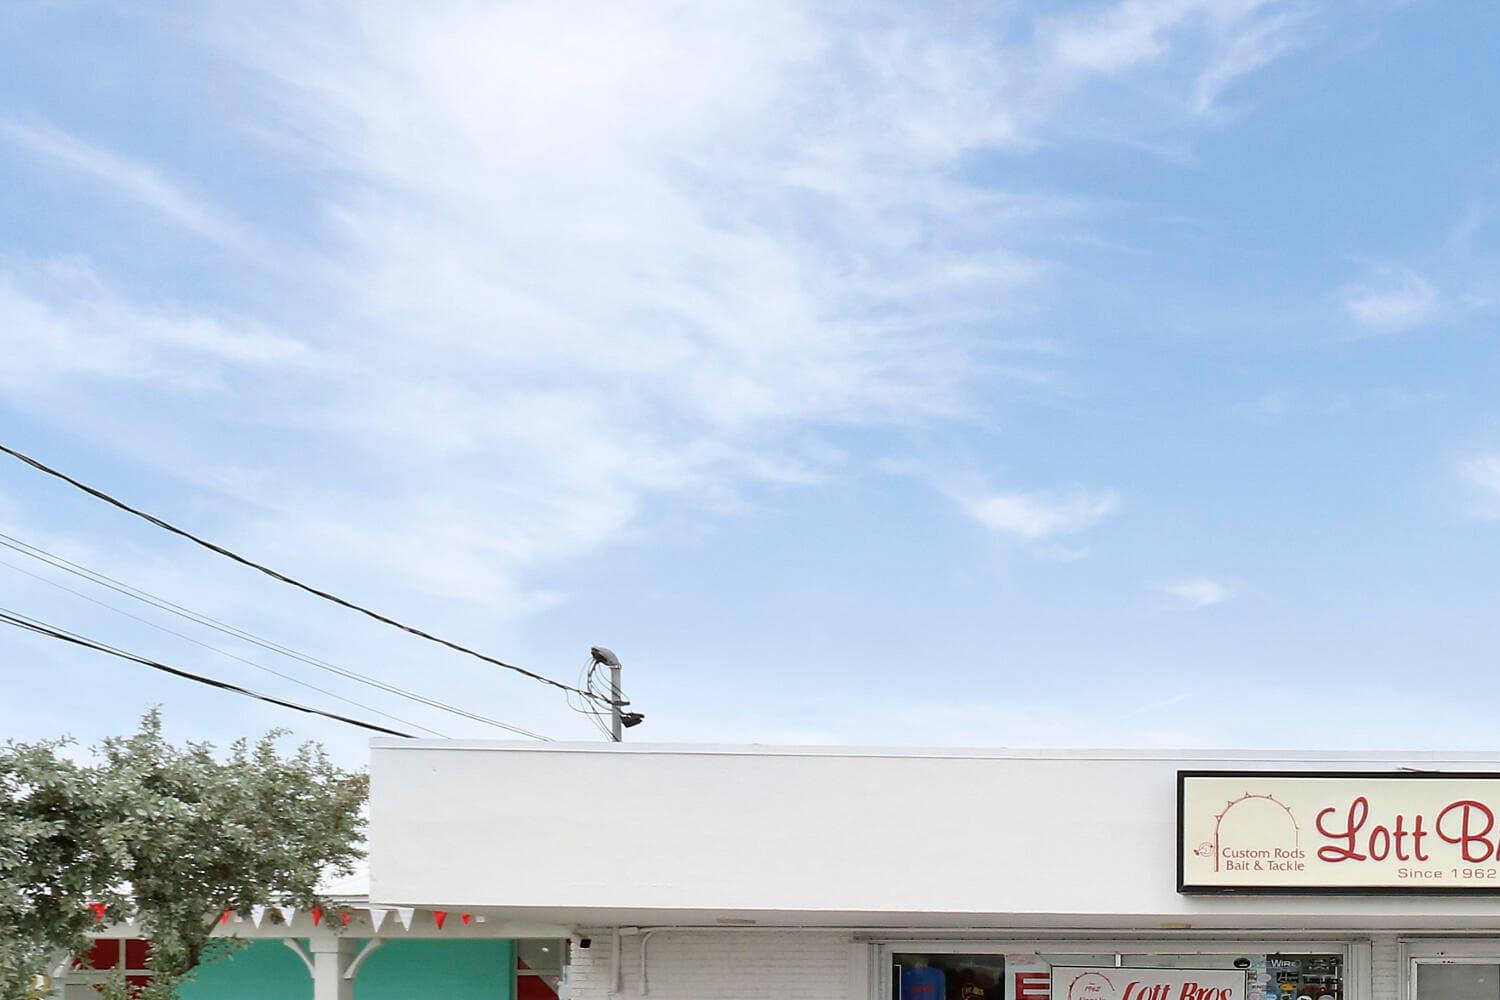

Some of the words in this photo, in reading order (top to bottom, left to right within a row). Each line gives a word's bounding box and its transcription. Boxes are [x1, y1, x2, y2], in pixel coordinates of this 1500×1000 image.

[1316, 796, 1429, 862] Lott
[1222, 847, 1270, 858] Custom
[1274, 847, 1305, 858] Rods
[1226, 860, 1250, 871] Bait
[1253, 860, 1264, 871] &
[1267, 860, 1305, 871] Tackle
[1397, 868, 1443, 879] Since
[1451, 868, 1497, 879] 1962
